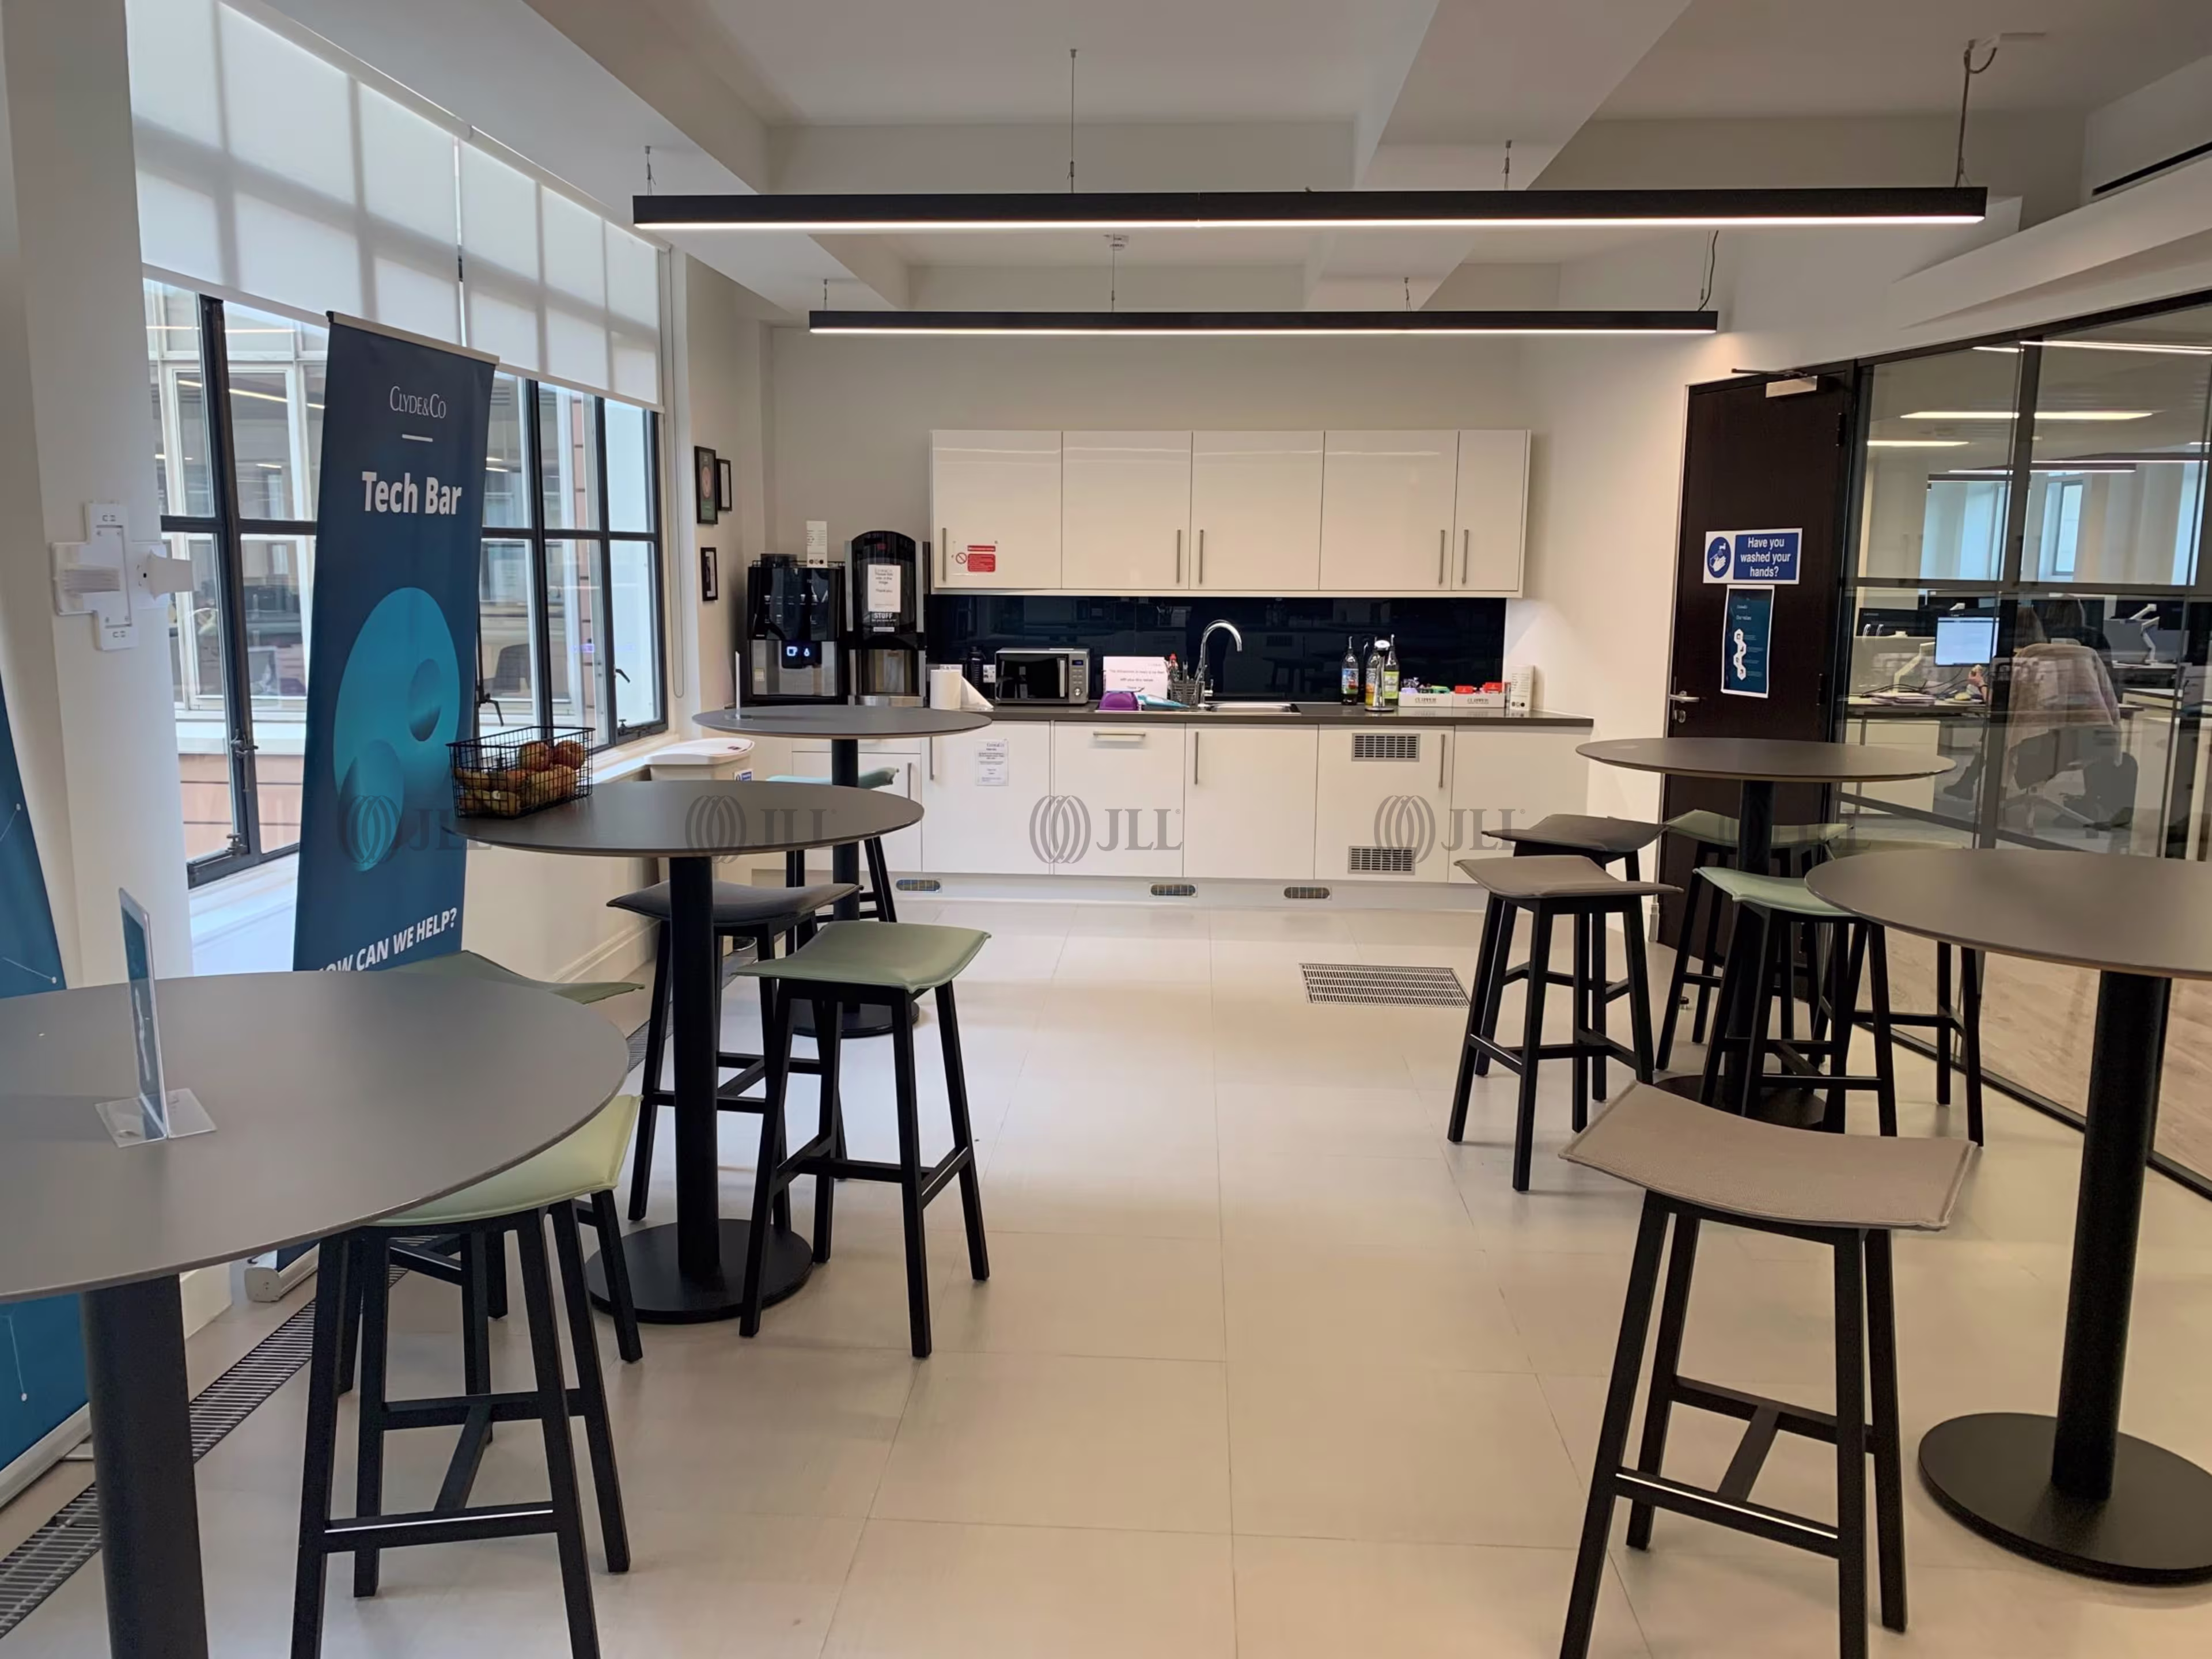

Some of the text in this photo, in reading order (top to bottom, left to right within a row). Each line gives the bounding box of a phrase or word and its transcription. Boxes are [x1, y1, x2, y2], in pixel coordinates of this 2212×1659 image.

[362, 471, 462, 515] Tech Bar
[1748, 537, 1785, 550] Have you
[1740, 551, 1791, 565] washed your
[1750, 566, 1779, 577] hands?
[356, 938, 389, 972] CAN
[393, 926, 415, 955] WE
[416, 907, 457, 943] HELP?
